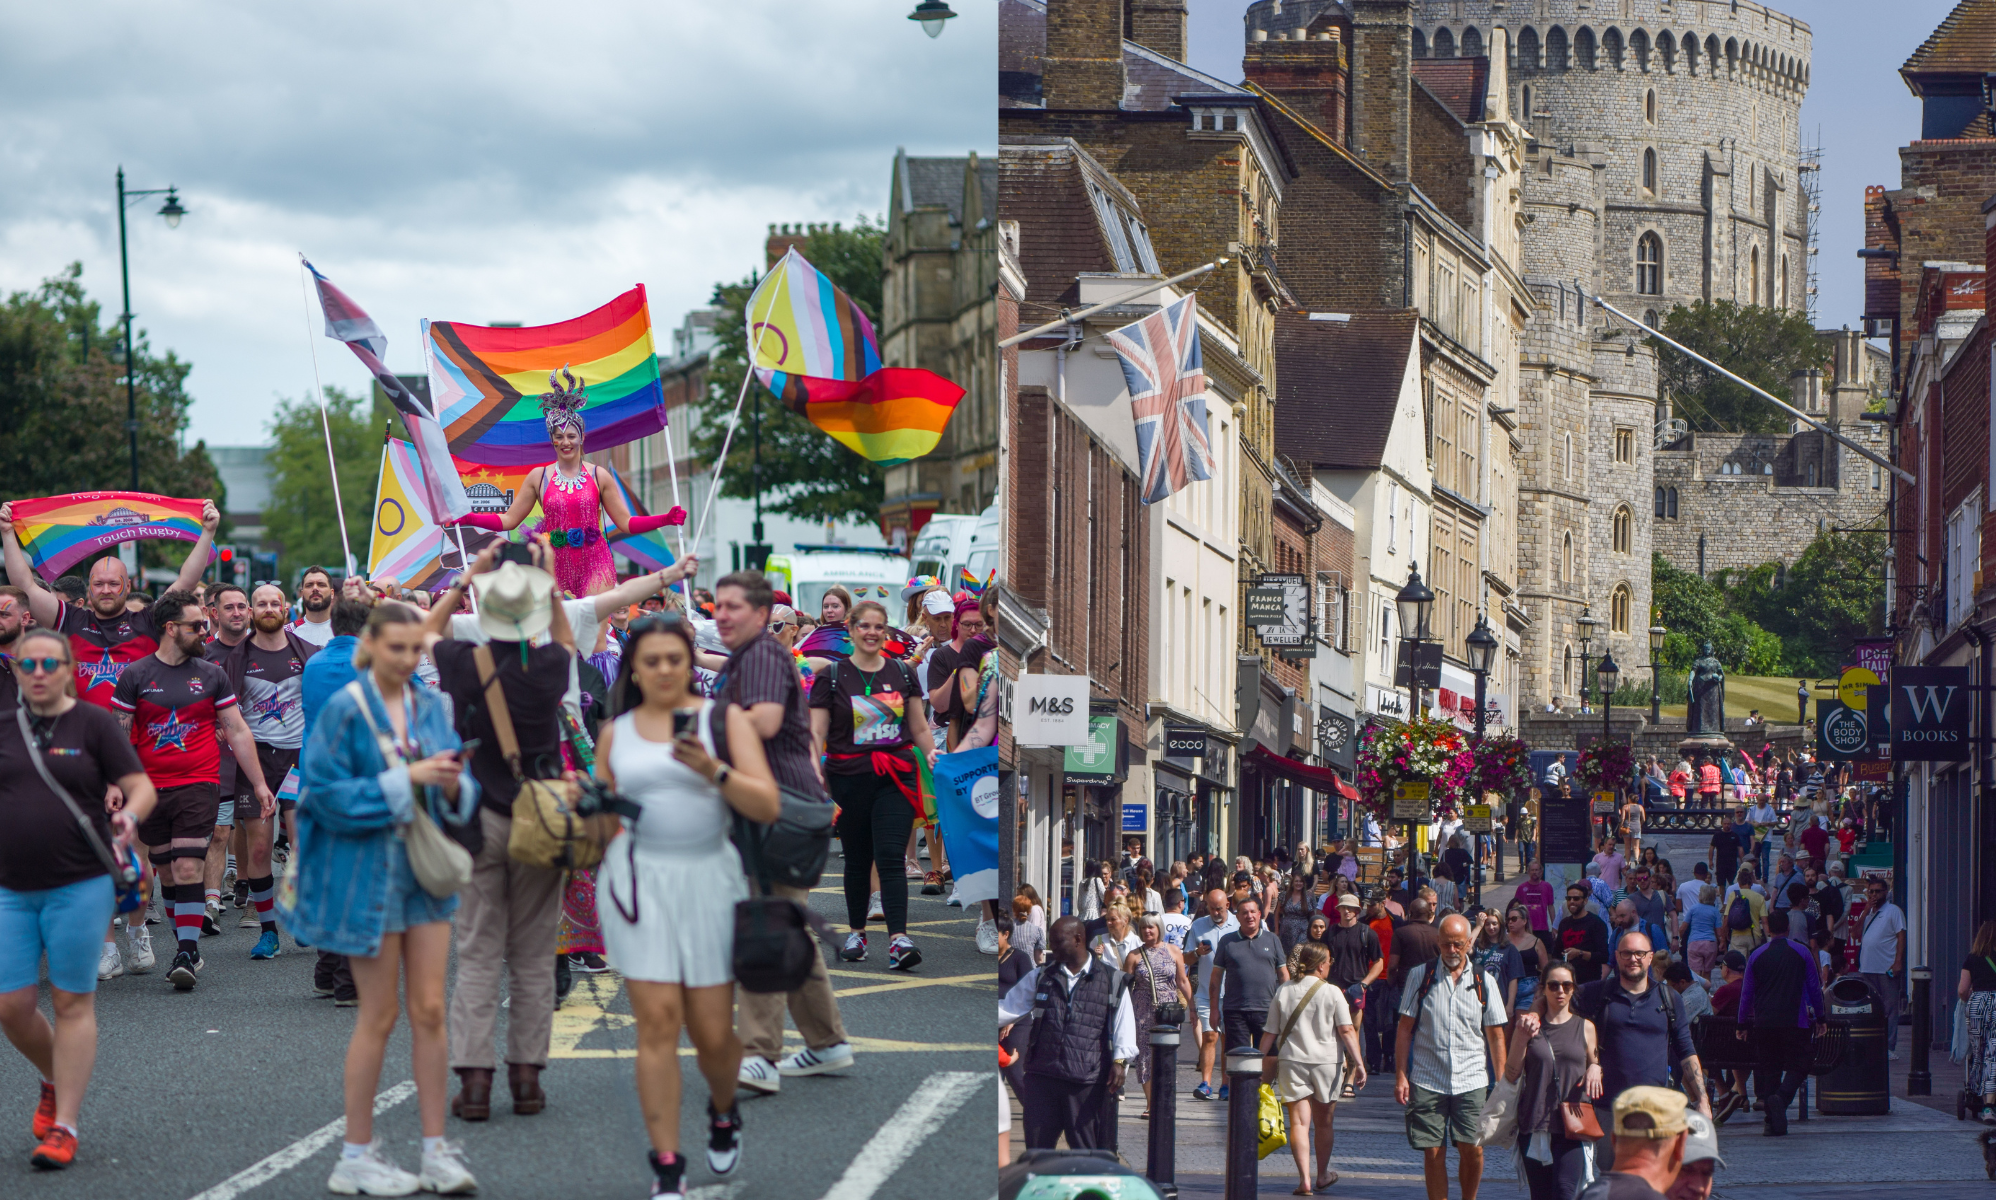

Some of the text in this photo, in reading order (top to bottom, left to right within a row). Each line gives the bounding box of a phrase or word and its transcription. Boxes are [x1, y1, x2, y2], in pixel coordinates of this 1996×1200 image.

[94, 527, 181, 546] Touch Rugby
[1031, 696, 1074, 714] M&S
[1902, 685, 1958, 724] W
[1319, 719, 1348, 734] BLACK SHEEP
[1833, 728, 1862, 736] BODY
[1835, 736, 1861, 745] SHOP
[1902, 730, 1958, 742] BOOKS
[1170, 740, 1203, 750] ecco
[1324, 737, 1346, 748] COFFEE
[953, 763, 998, 786] SUPPORTE
[1066, 776, 1108, 785] Superdrug
[956, 786, 968, 796] BY
[975, 794, 983, 804] BT
